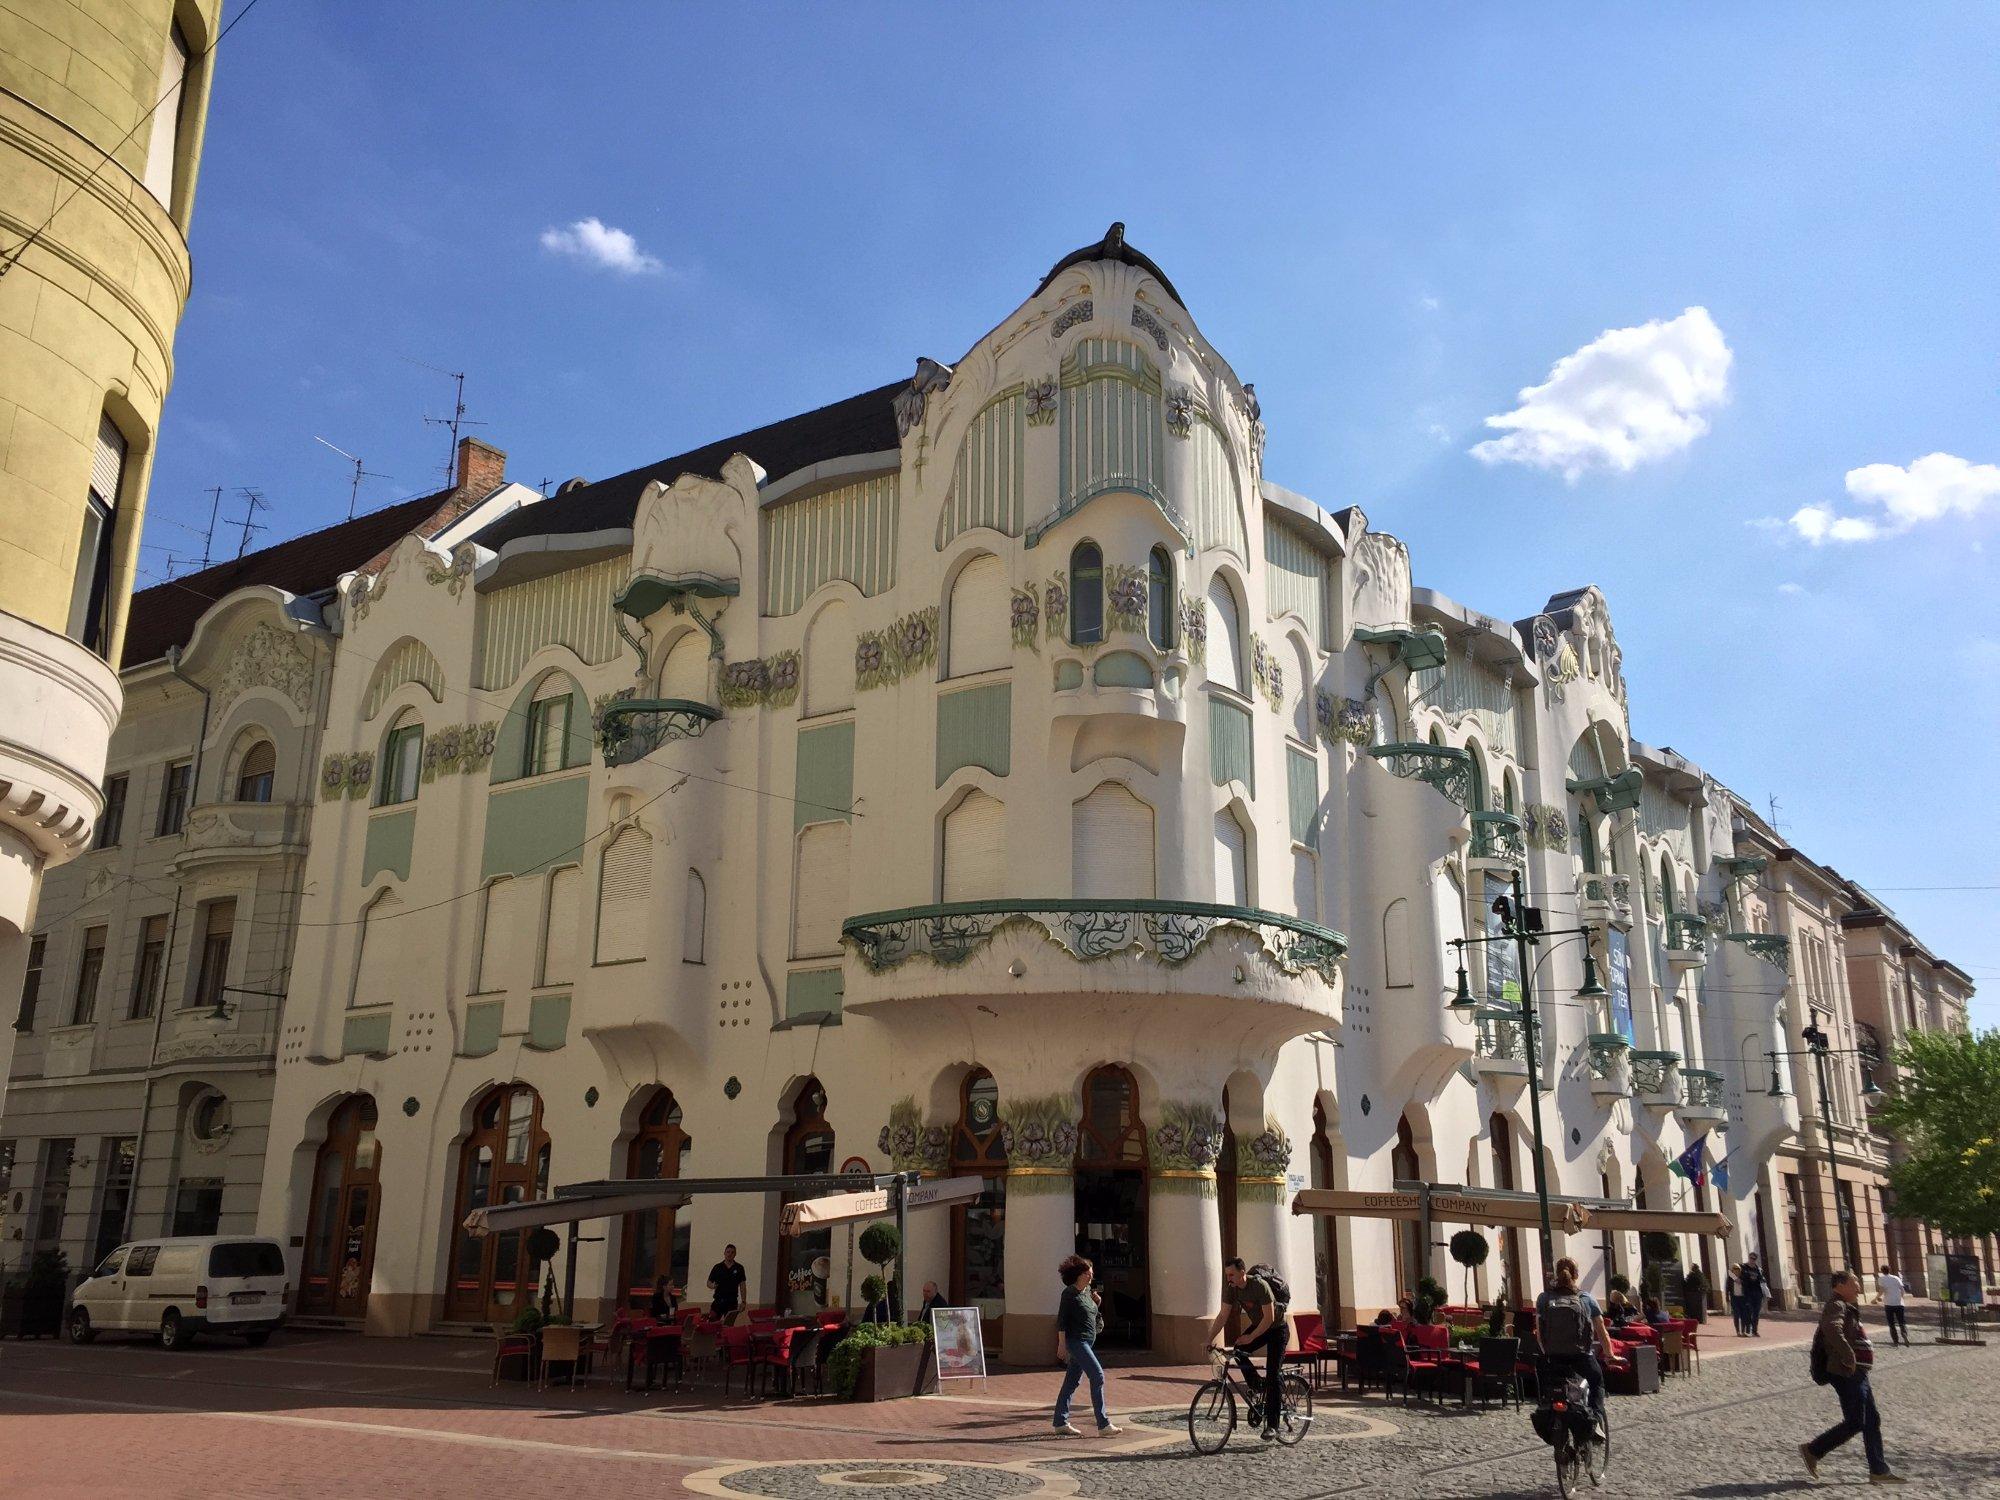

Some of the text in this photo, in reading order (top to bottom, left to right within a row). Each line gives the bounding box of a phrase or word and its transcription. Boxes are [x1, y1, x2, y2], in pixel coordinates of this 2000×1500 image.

[907, 1188, 938, 1203] OMPANY
[1364, 1196, 1487, 1212] COFFEESHO COMPANY
